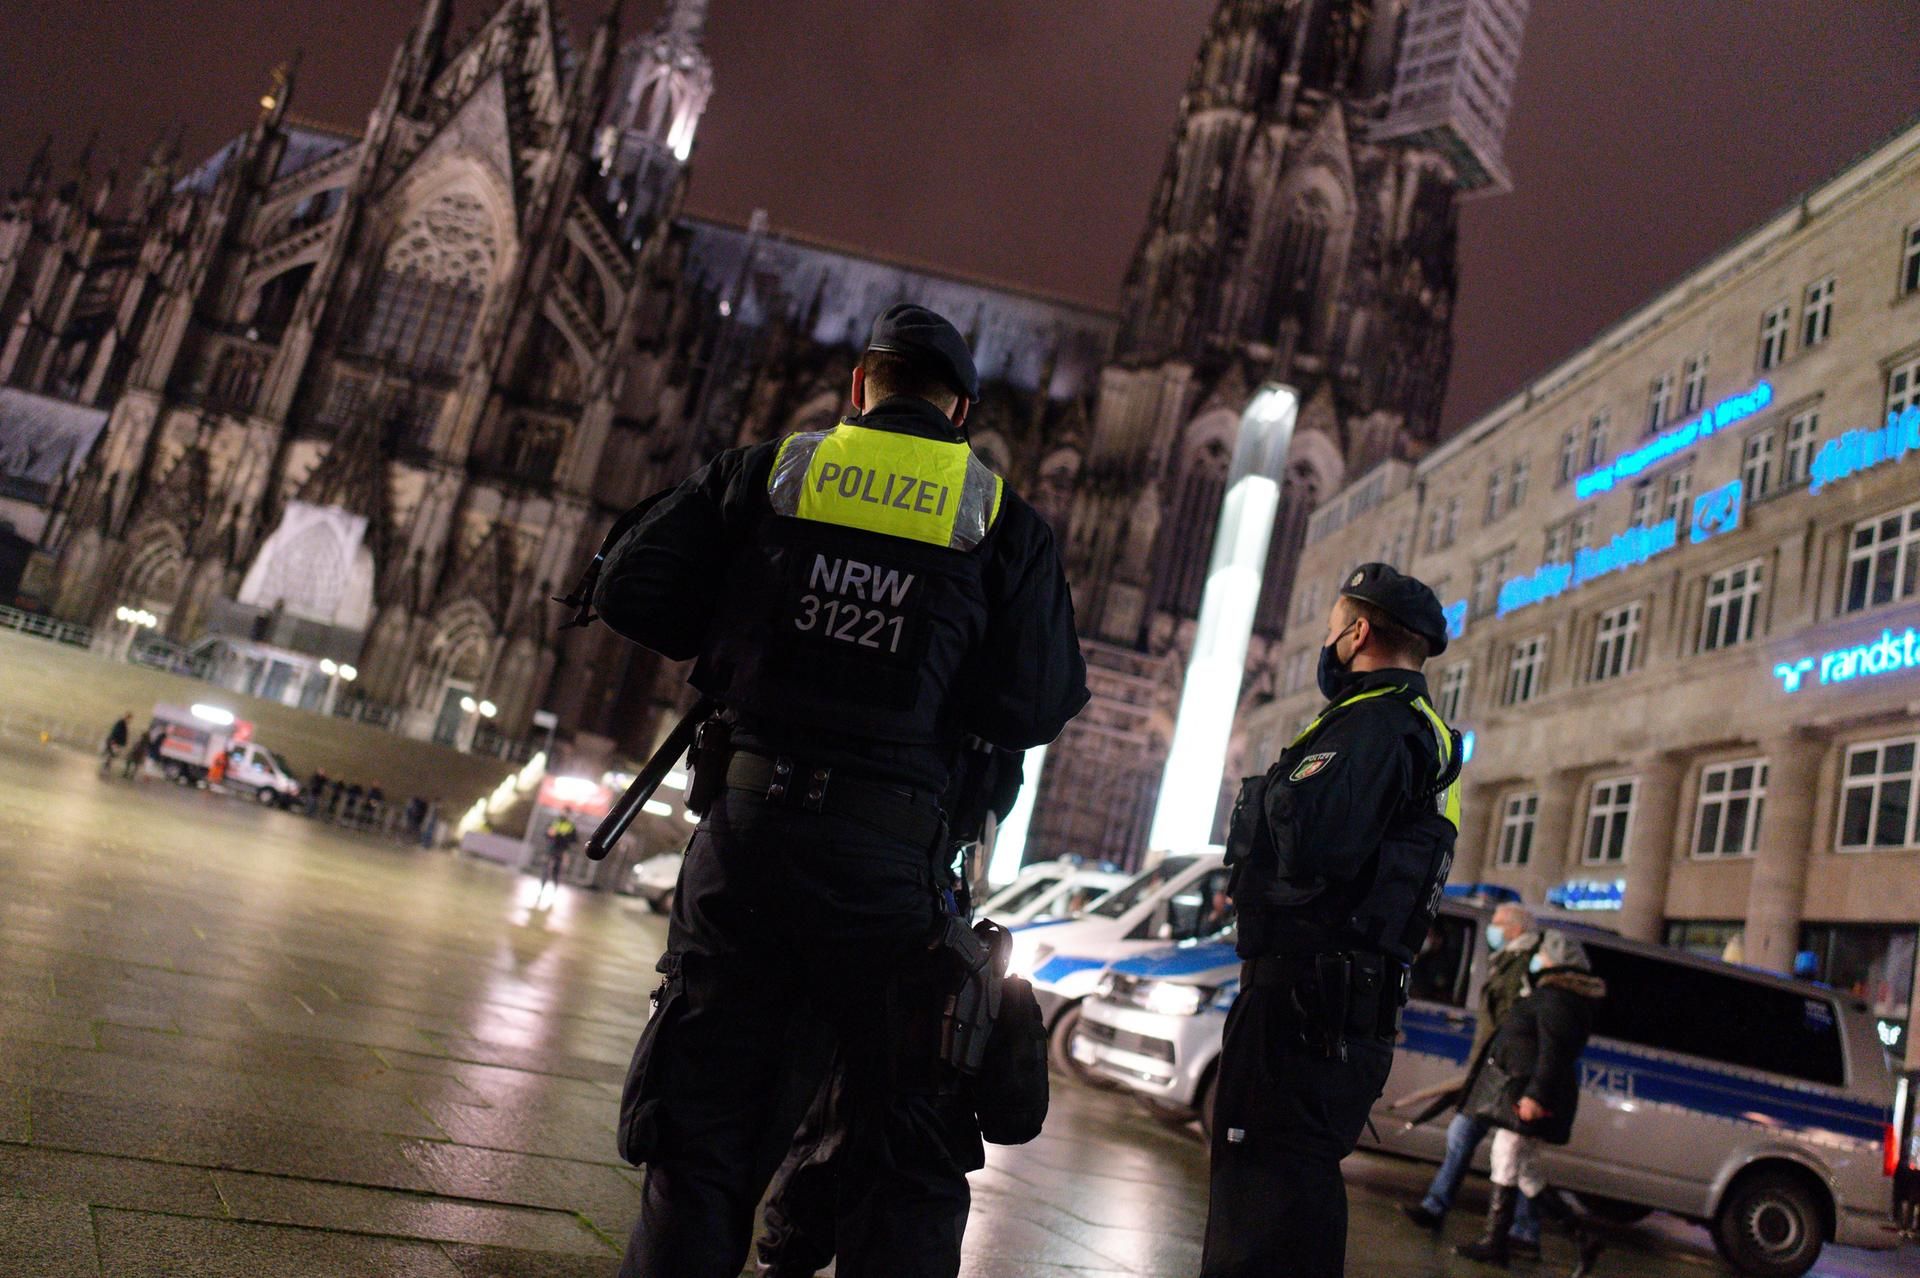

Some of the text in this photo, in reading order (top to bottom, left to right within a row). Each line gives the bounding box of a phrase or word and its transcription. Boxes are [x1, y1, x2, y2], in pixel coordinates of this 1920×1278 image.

[815, 462, 949, 516] POLIZEI
[809, 553, 915, 608] NRW
[794, 594, 905, 653] 31221
[1581, 1060, 1635, 1099] IZEI
